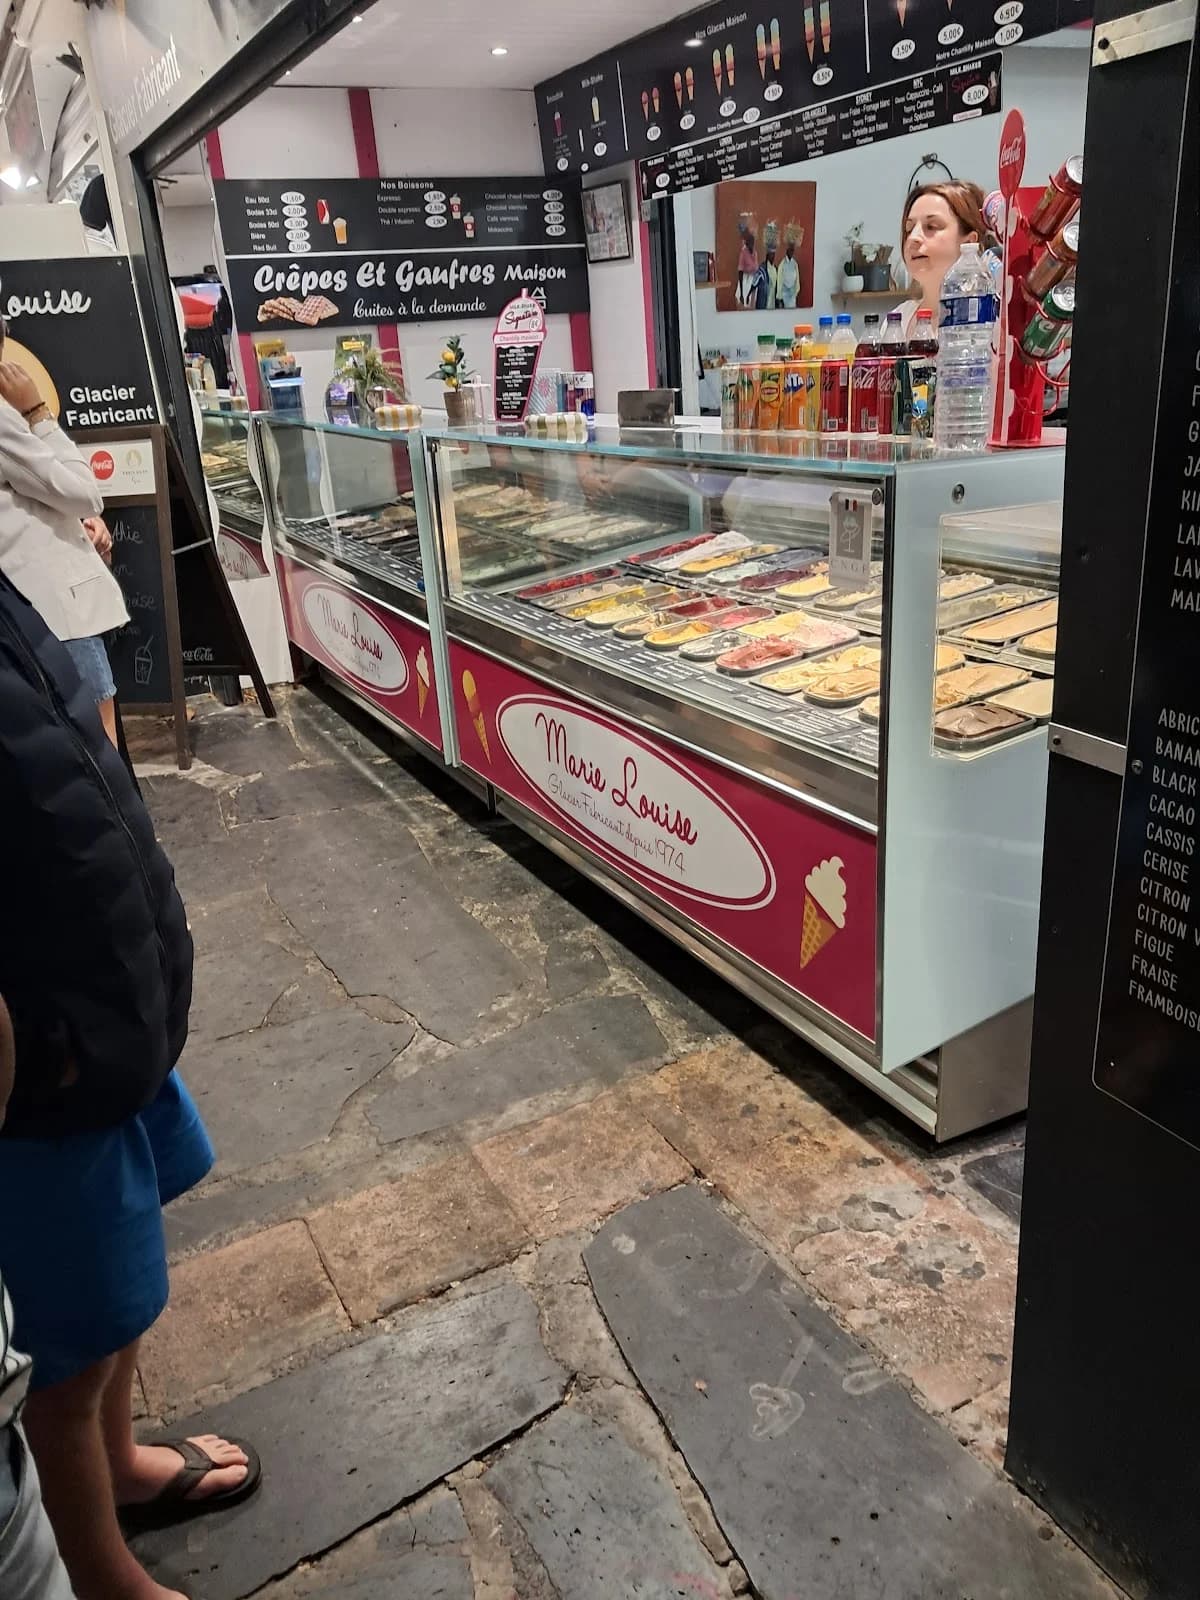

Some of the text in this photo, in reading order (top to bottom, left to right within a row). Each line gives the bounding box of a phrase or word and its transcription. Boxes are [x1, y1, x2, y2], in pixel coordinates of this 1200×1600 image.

[706, 21, 726, 36] Glaces
[726, 12, 746, 27] Maison
[936, 26, 1019, 60] Notre Chantilly Maison 1,00€
[133, 32, 181, 118] Fabricant
[380, 180, 434, 190] Nos Boissons
[254, 258, 567, 296] Crêpes Et Gaufres Maison
[398, 302, 408, 315] à
[411, 299, 425, 314] la
[428, 296, 486, 313] demande
[70, 384, 136, 404] Glacier
[784, 373, 804, 388] NTA
[66, 405, 154, 426] Fabricant
[317, 594, 348, 640] Marie
[350, 612, 382, 660] Louise
[535, 712, 698, 845] Marie Louise
[1152, 764, 1197, 797] BLACK
[548, 773, 685, 874] Glacier Fabricant depuis 1974
[1149, 794, 1196, 826] CACAO
[1146, 822, 1196, 856] CASSIS
[1143, 850, 1190, 884] CERISE
[1140, 877, 1191, 913] CITRON
[1137, 903, 1188, 940] CITRON
[1134, 928, 1176, 963] FIGUE
[1131, 954, 1179, 992] FRAISE
